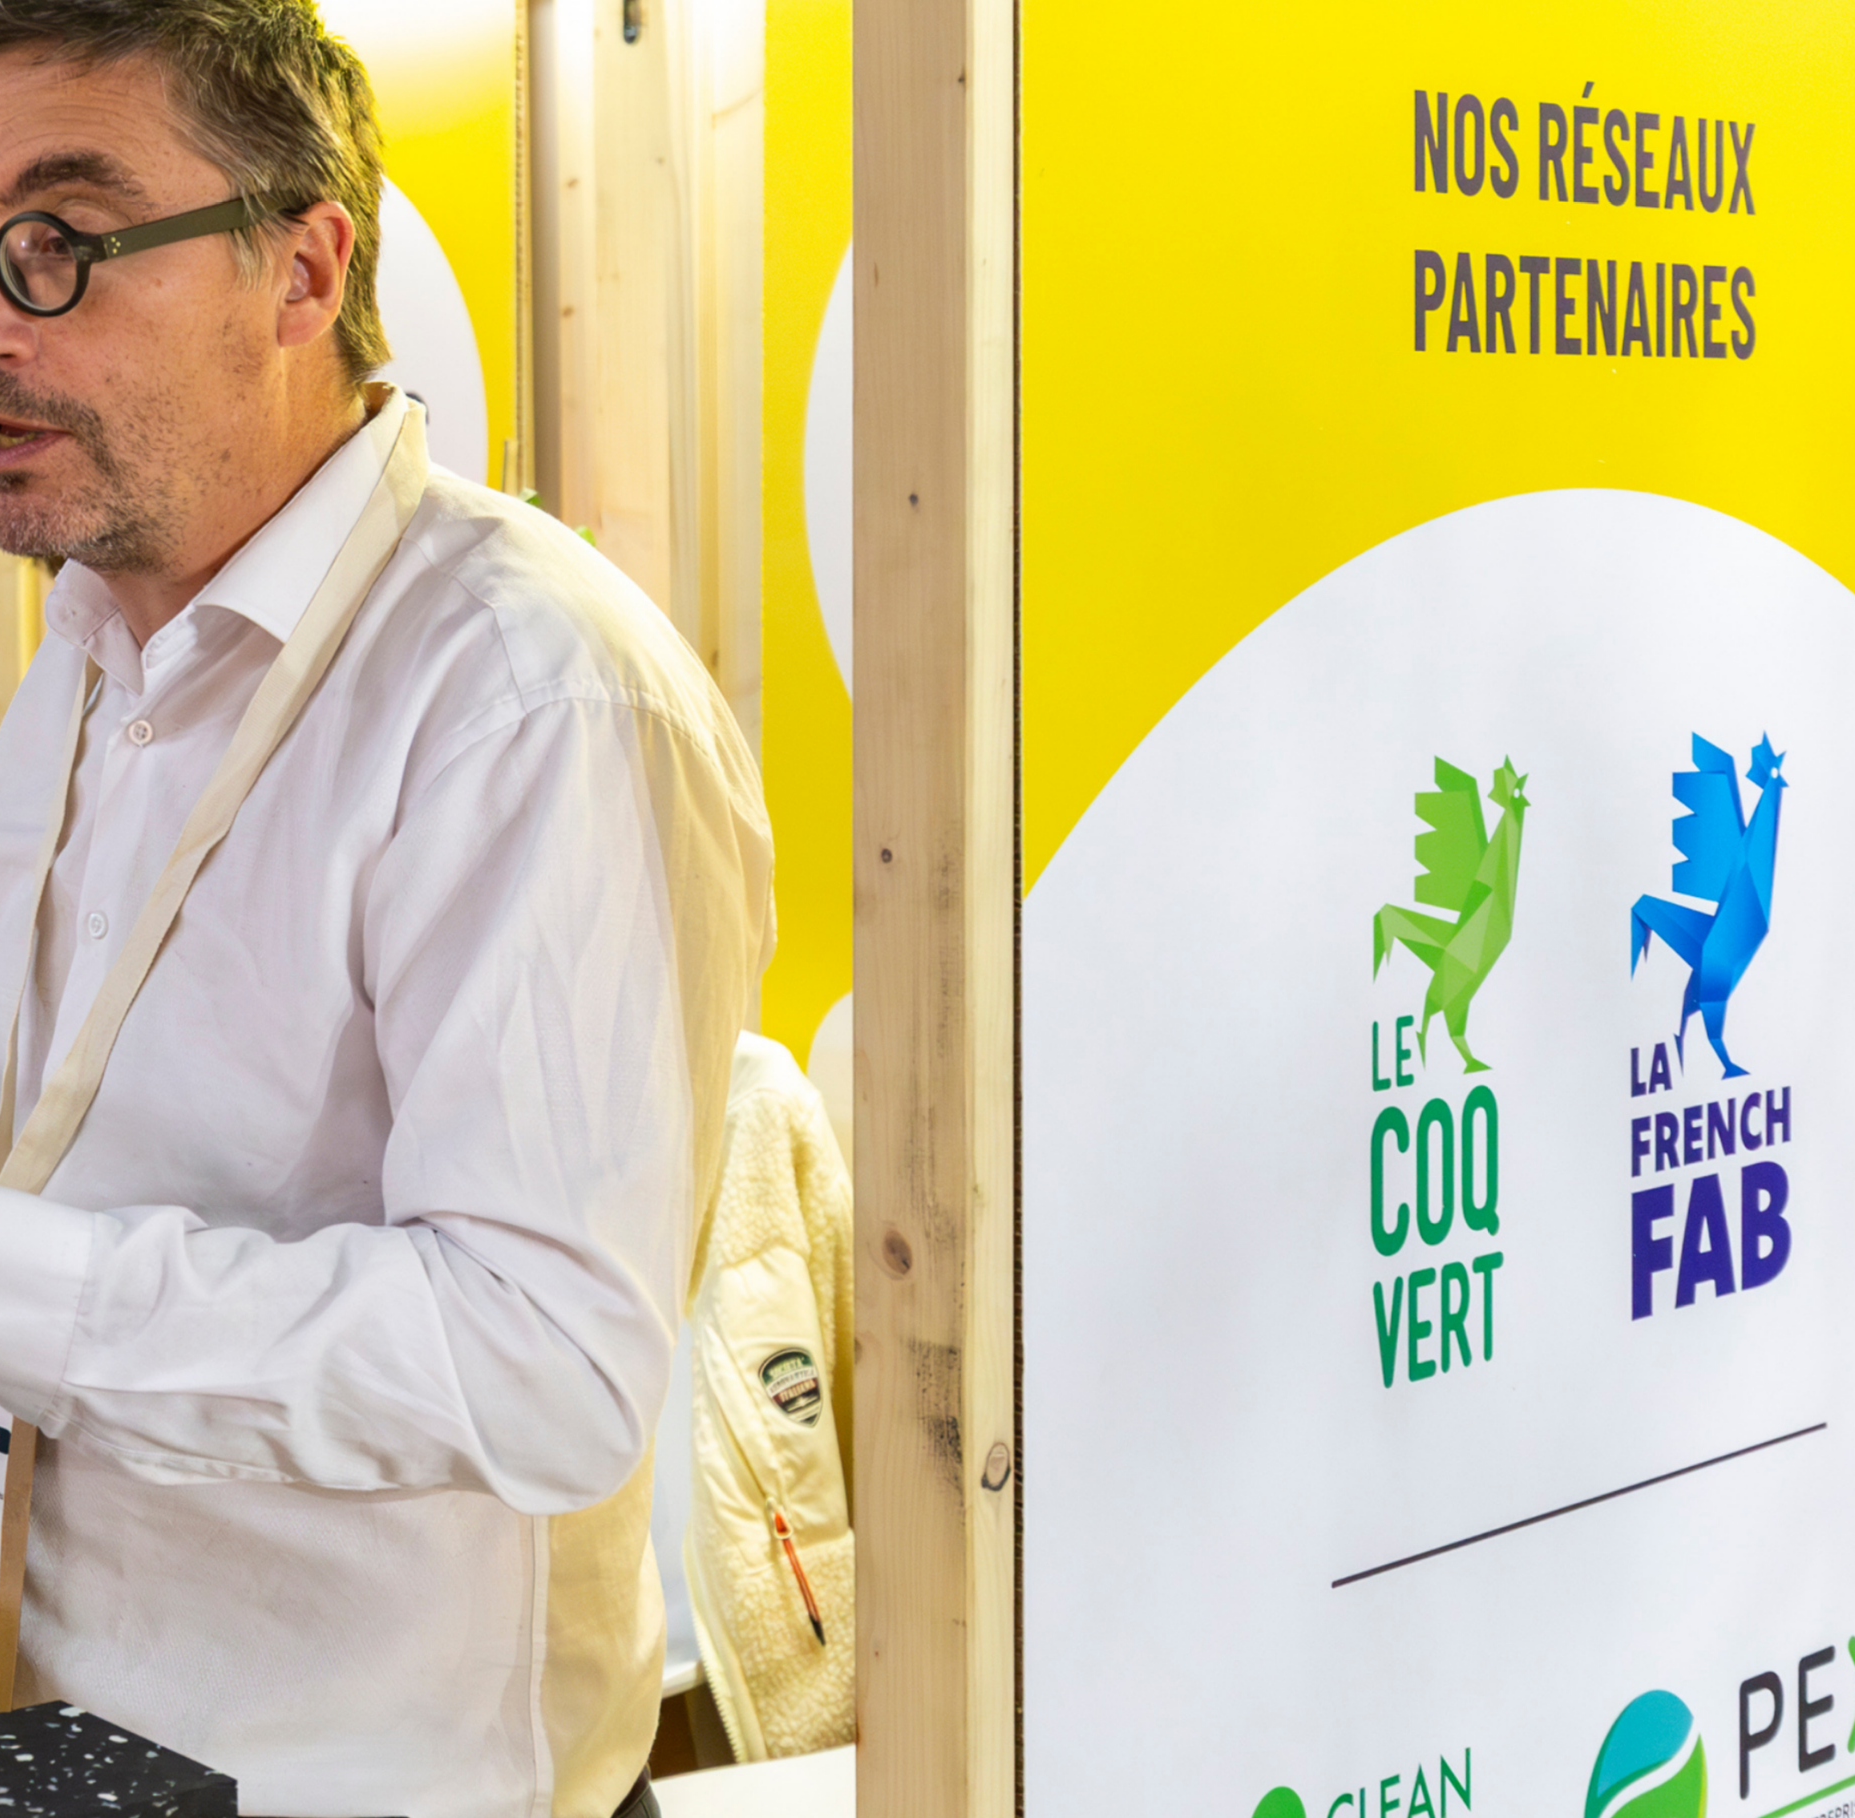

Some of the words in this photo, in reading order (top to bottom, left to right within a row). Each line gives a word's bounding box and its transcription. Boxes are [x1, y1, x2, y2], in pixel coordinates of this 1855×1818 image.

[1414, 89, 1520, 199] NOS
[1539, 81, 1756, 216] RÉSEAUX
[1414, 249, 1757, 361] PARTENAIRES
[1372, 1015, 1415, 1092] LE
[1630, 1042, 1673, 1098] LA
[1370, 1084, 1500, 1257] COQ
[1631, 1086, 1792, 1178] FRENCH
[1631, 1160, 1793, 1322] FAB
[1372, 1251, 1504, 1389] VERT
[1740, 1635, 1855, 1801] PE
